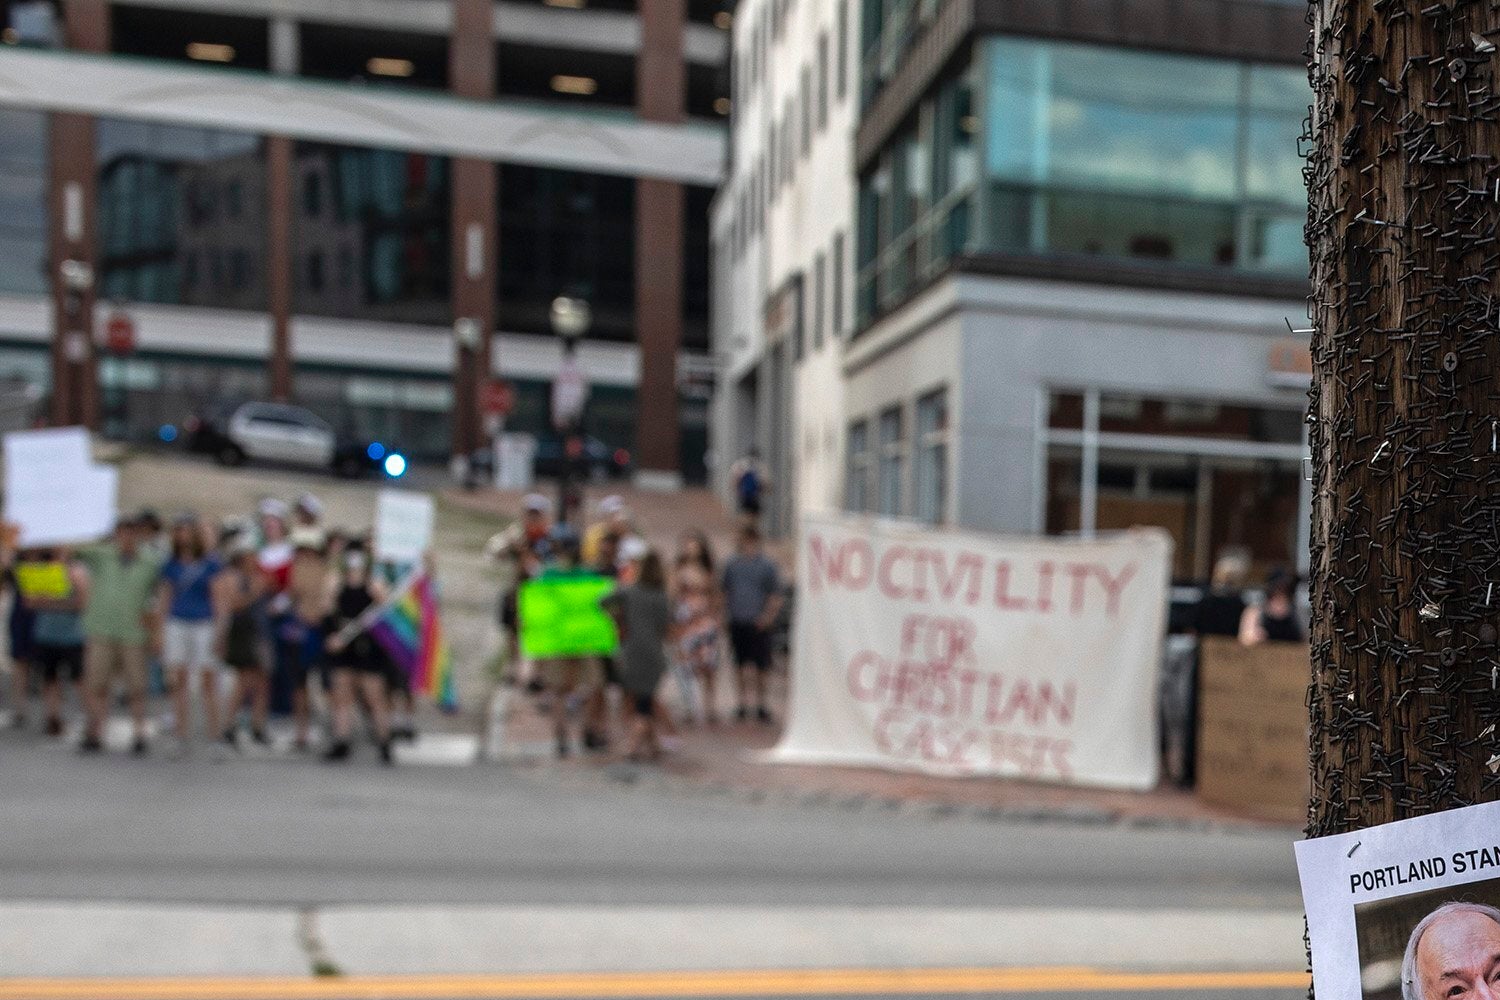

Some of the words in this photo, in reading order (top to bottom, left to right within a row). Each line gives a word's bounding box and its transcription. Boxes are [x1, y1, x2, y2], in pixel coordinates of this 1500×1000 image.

[808, 532, 874, 594] NO
[877, 546, 1140, 616] CIVILITY
[902, 613, 977, 669] FOR
[1350, 857, 1446, 893] PORTLAND
